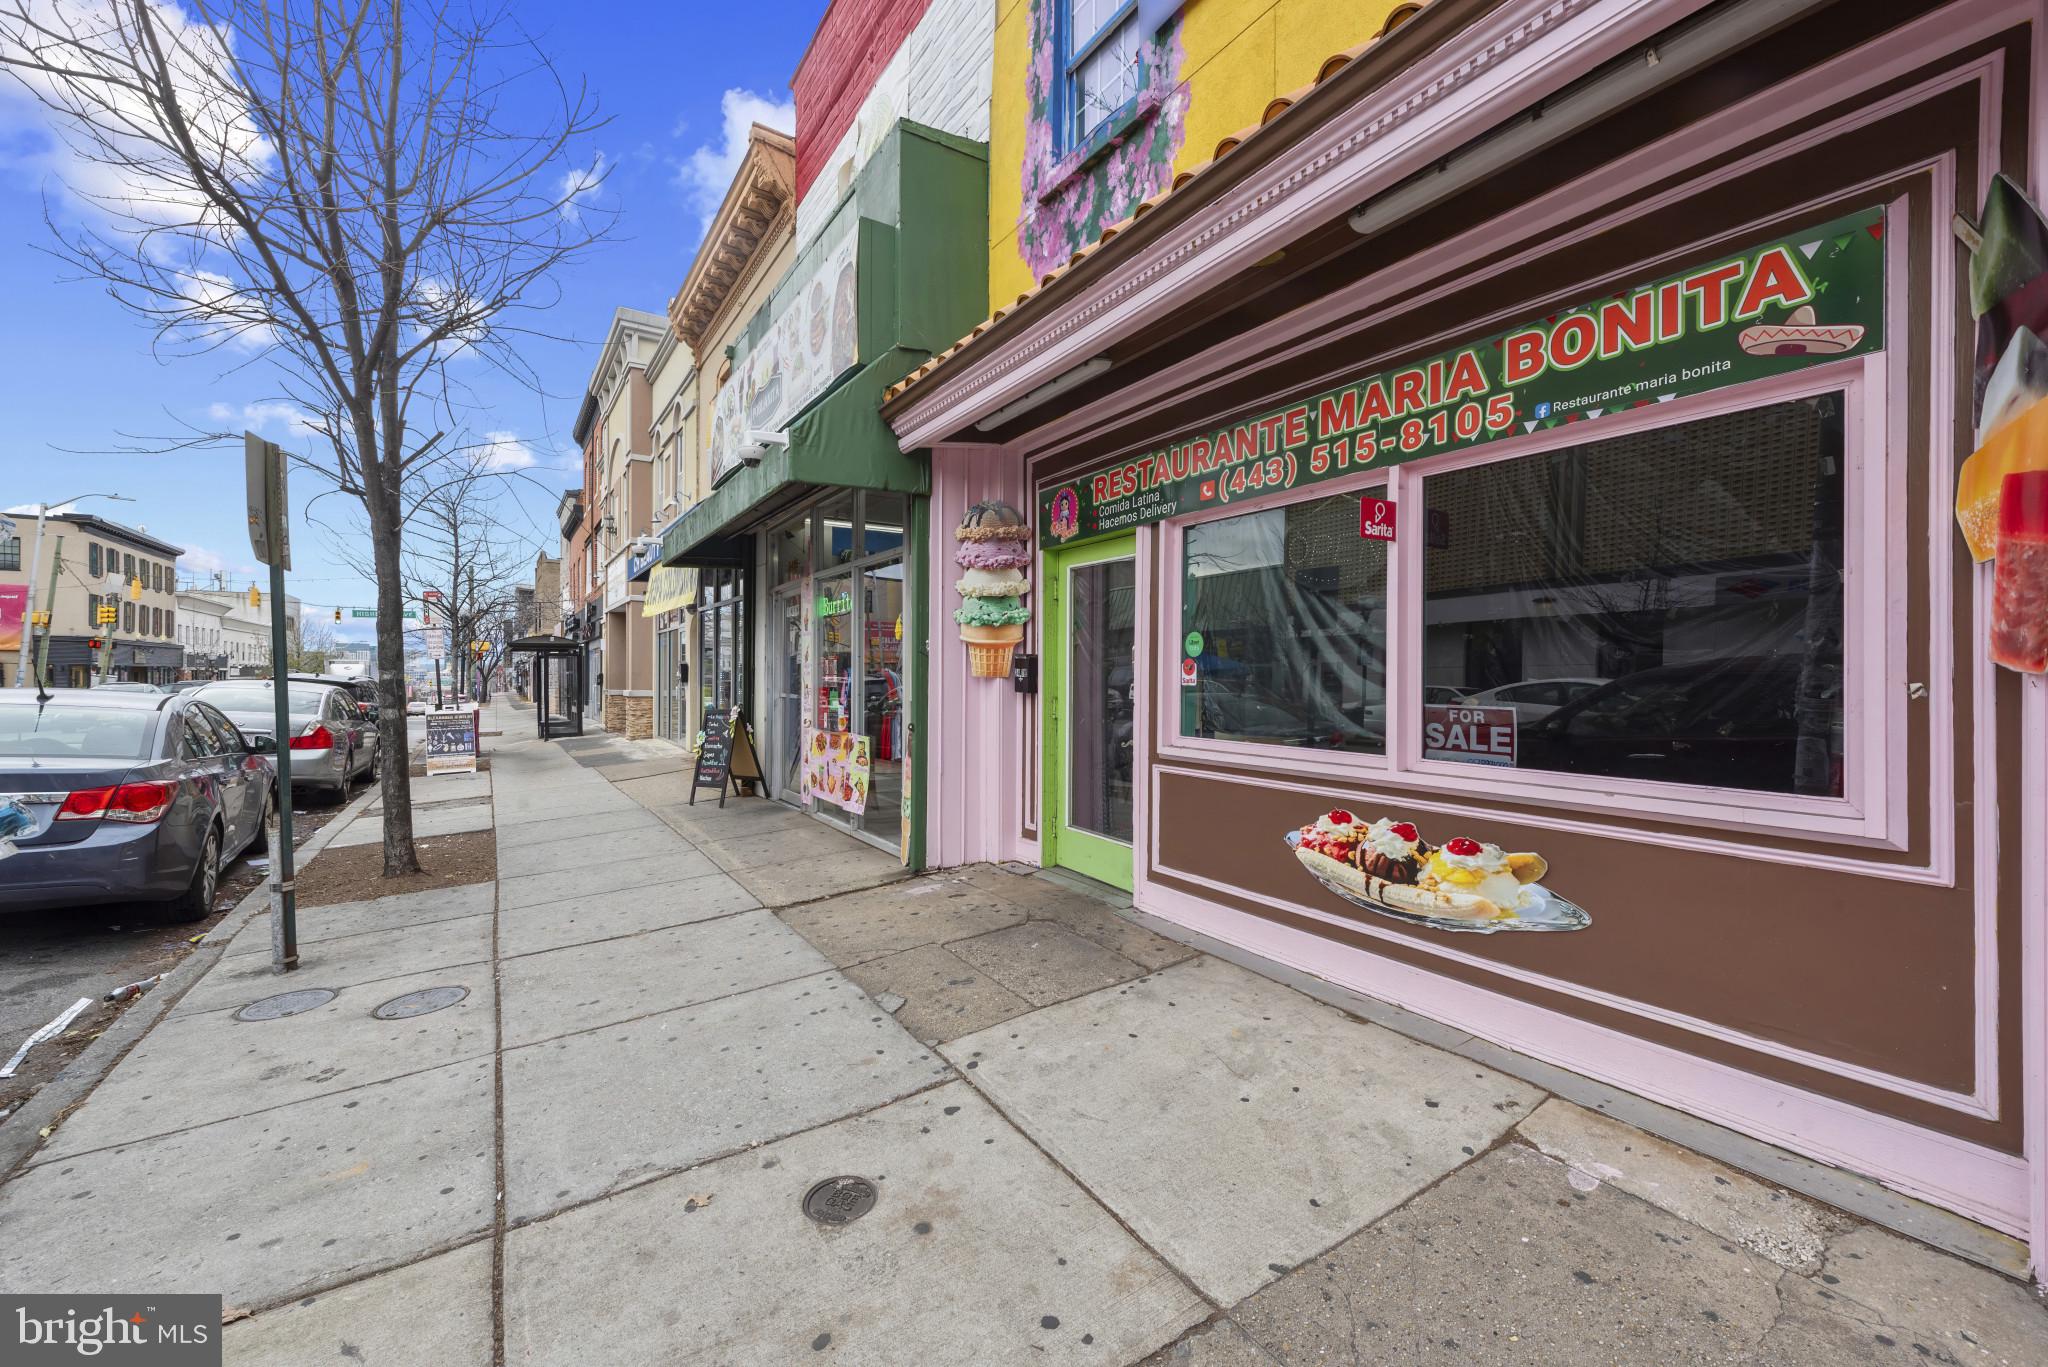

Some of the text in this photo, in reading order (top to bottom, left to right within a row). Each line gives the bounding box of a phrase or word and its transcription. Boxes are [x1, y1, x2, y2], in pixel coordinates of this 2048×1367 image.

[1093, 247, 1813, 505] RESTAURANTE MARIA BONITA
[1553, 385, 1632, 412] Restaurante
[1635, 373, 1677, 392] maria
[1682, 360, 1731, 380] bonita
[1220, 392, 1515, 503] (443) 515-8105
[1099, 492, 1160, 517] Comida Latina
[1099, 501, 1177, 530] Hacemos Delivery
[1365, 521, 1393, 538] Sarita
[1449, 709, 1485, 723] FOR
[1425, 722, 1512, 753] SALE
